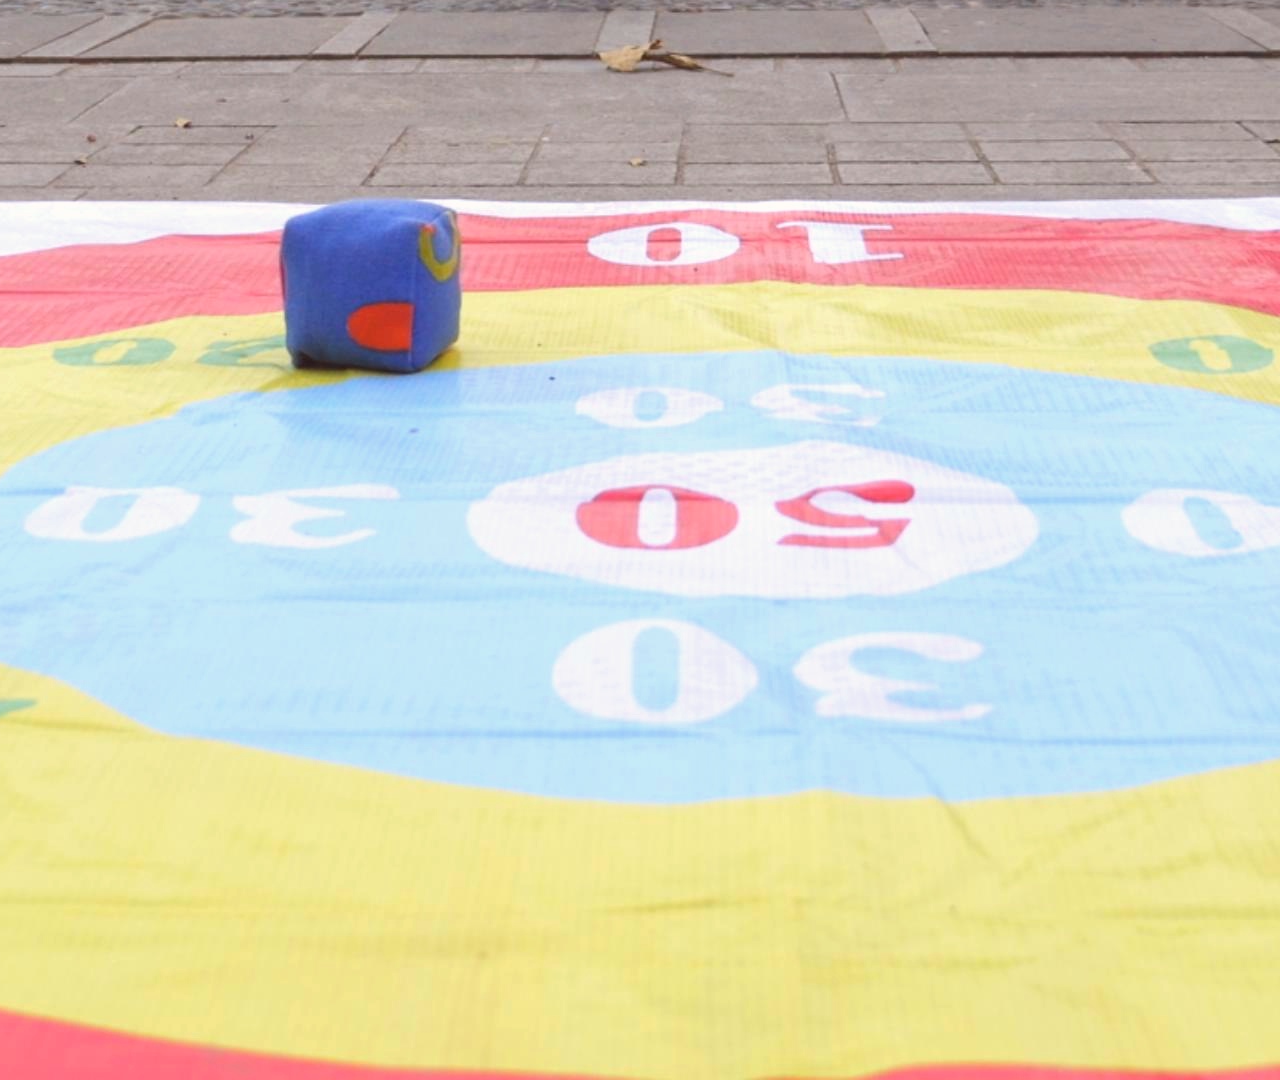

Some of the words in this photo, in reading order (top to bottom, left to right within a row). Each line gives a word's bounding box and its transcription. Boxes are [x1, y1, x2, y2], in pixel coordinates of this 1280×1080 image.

[587, 221, 904, 266] 10
[575, 383, 886, 428] 30
[23, 483, 401, 551] 30
[575, 480, 915, 550] 50
[551, 617, 993, 724] 30
